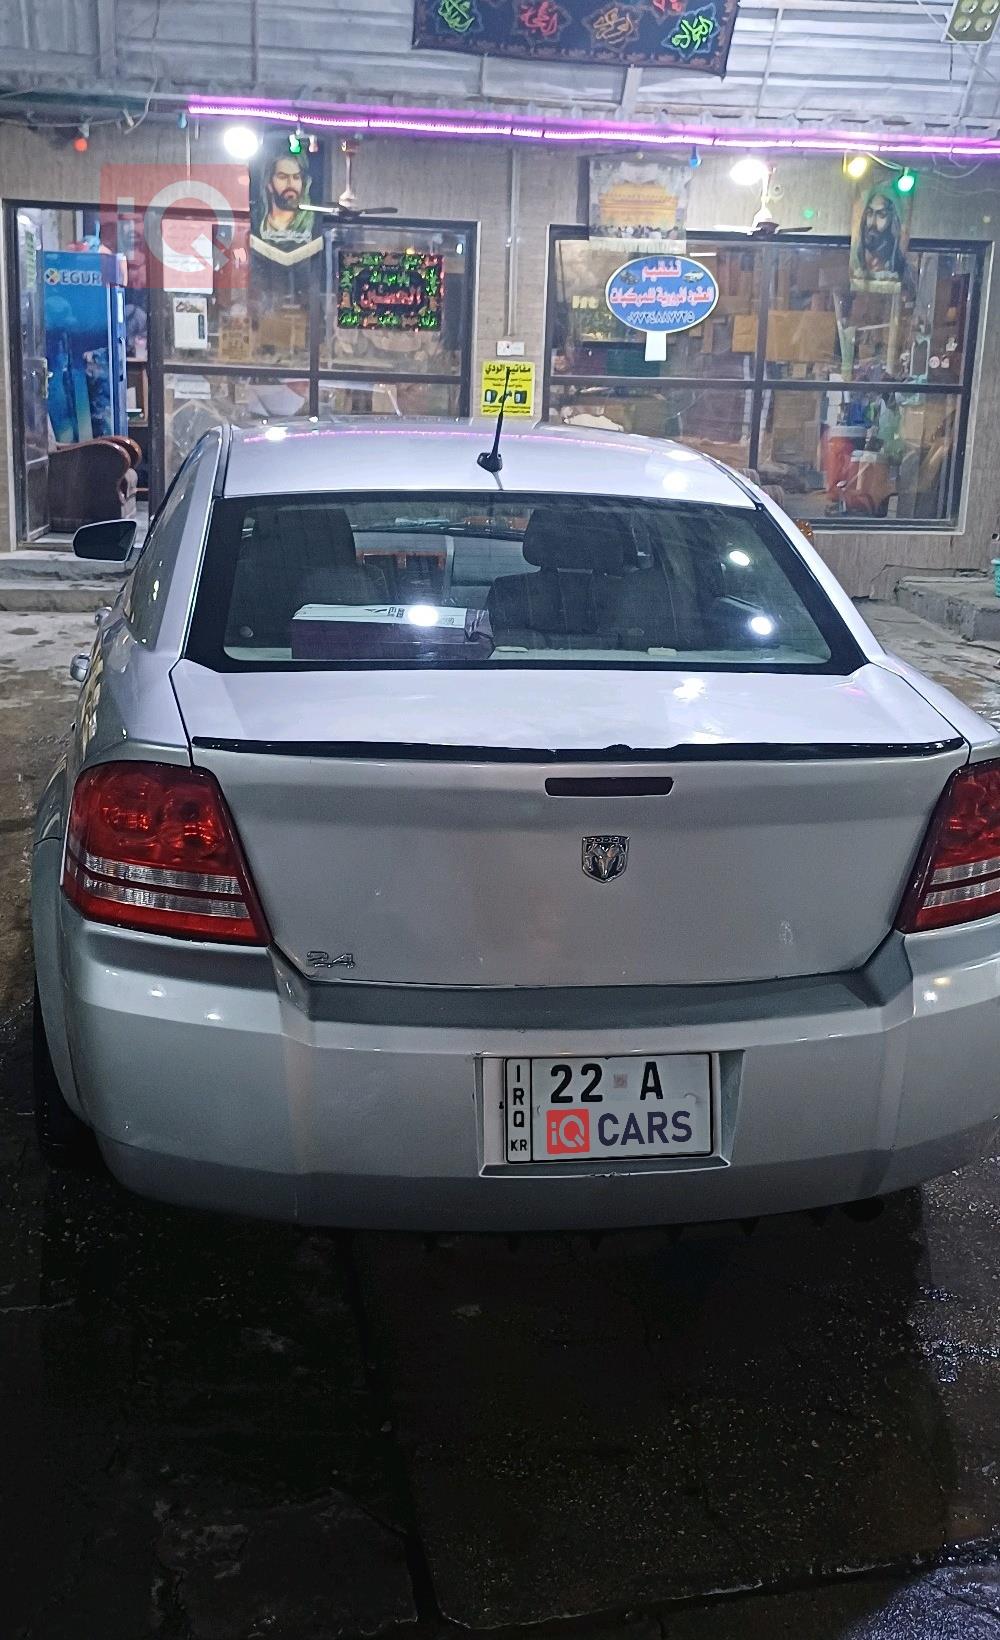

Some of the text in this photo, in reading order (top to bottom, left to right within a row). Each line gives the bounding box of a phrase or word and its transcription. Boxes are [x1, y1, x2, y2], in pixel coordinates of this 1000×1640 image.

[642, 261, 682, 282] تنظيم
[550, 1061, 663, 1103] 22 A
[510, 1139, 528, 1152] KR
